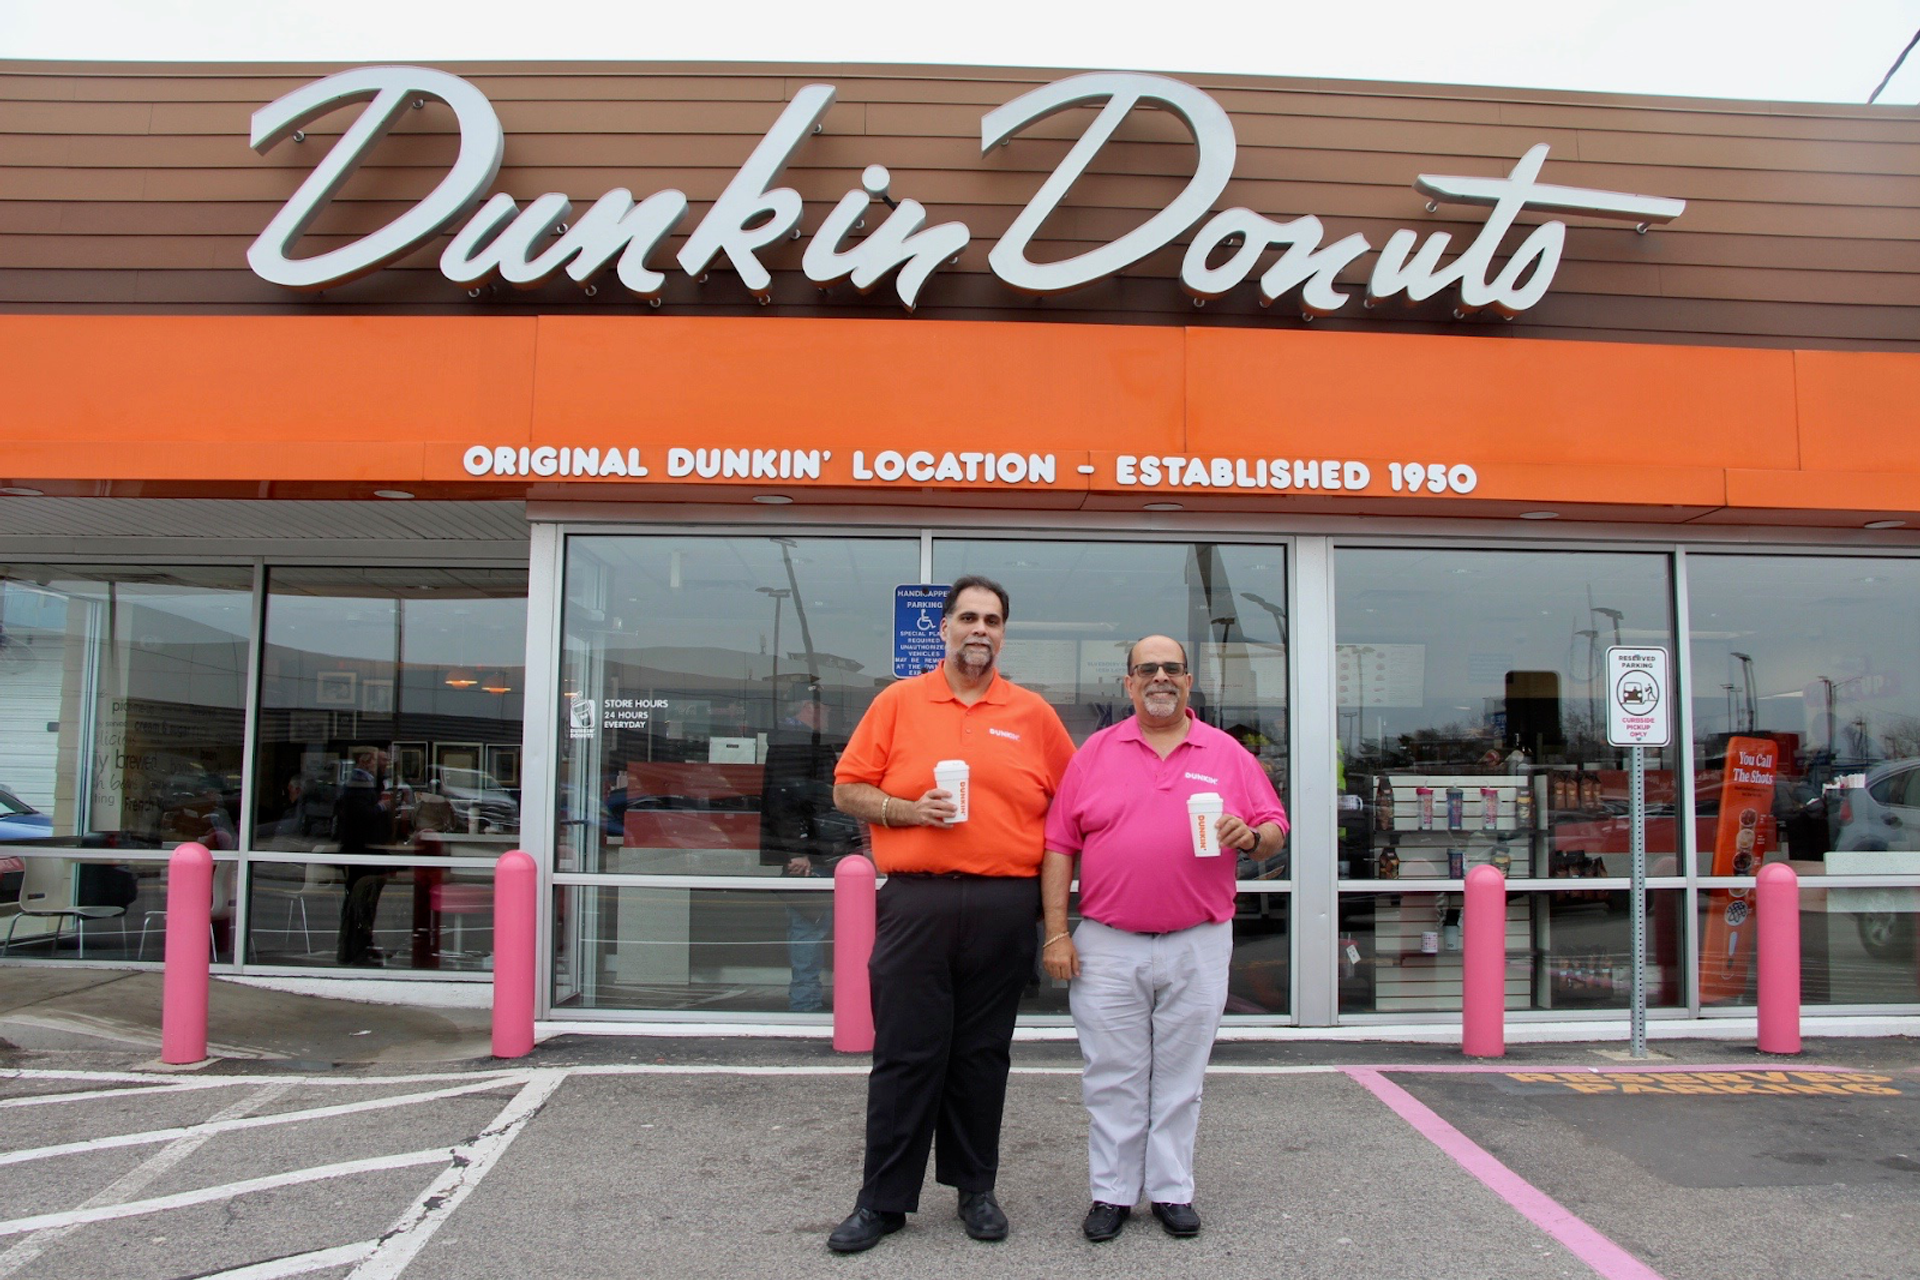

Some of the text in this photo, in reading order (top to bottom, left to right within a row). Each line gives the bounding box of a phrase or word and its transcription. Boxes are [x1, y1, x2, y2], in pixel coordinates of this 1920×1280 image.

[246, 65, 1686, 314] Dunkin Donuts
[463, 445, 648, 478] ORIGINAL
[667, 447, 831, 480] DUNKIN'
[852, 450, 1056, 484] LOCATION
[1115, 455, 1370, 490] ESTABLISHED
[1388, 462, 1478, 494] 1950
[604, 699, 669, 708] STORE HOURS
[604, 711, 648, 719] 24 HOURS
[1739, 751, 1773, 768] You Call
[1733, 767, 1774, 785] The Shots
[1504, 1071, 1894, 1084] RESERVED
[1562, 1082, 1903, 1095] PARKING
